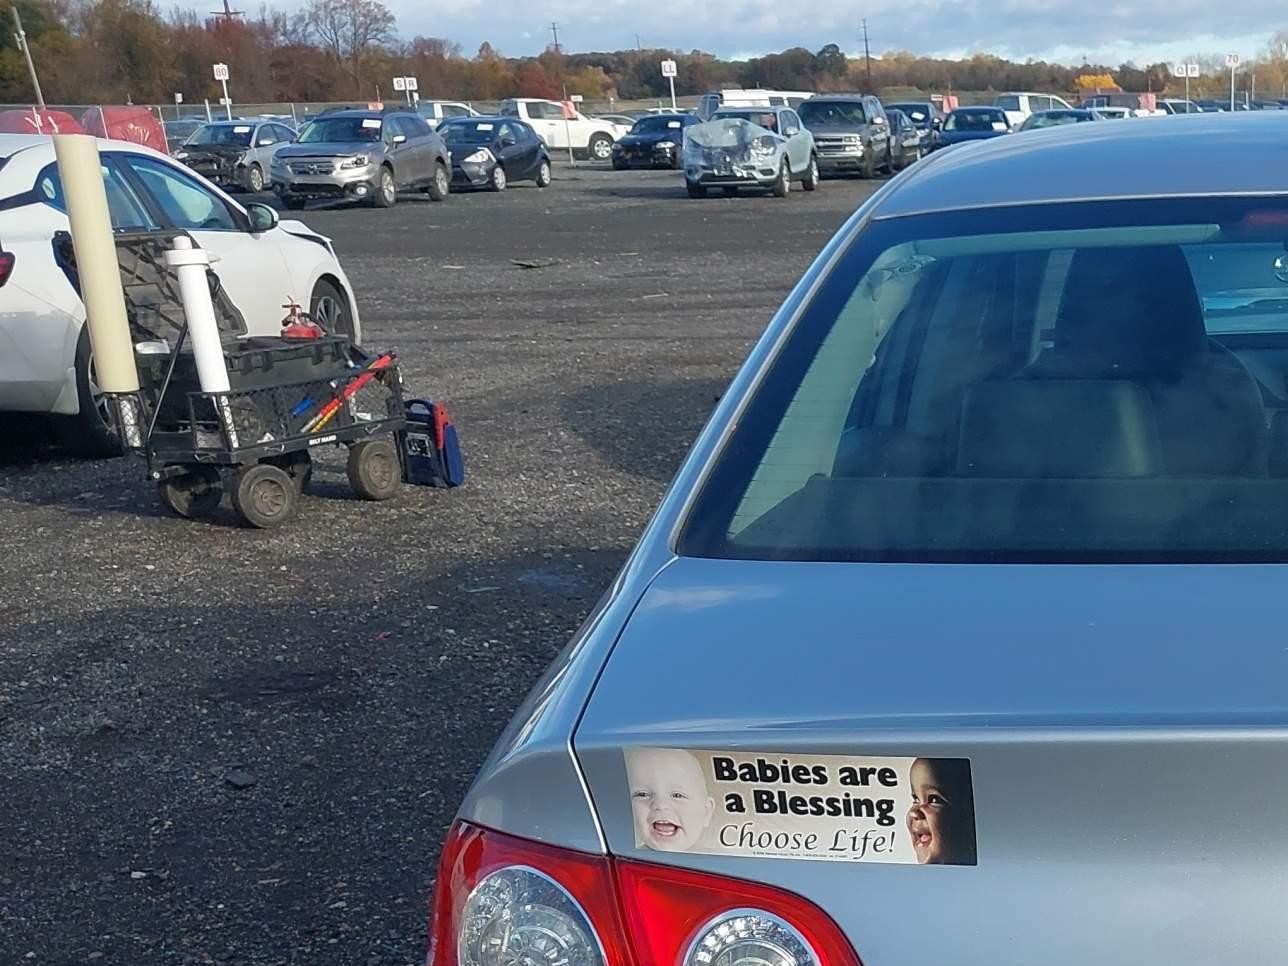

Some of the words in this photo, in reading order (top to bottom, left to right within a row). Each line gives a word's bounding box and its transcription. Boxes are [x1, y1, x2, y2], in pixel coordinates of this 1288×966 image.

[215, 67, 227, 77] 80
[1226, 54, 1239, 64] 70
[712, 756, 829, 785] Babies
[838, 765, 898, 787] are
[725, 792, 746, 813] a
[753, 789, 896, 826] Blessing
[719, 822, 818, 850] Choose
[828, 829, 896, 860] Life!
